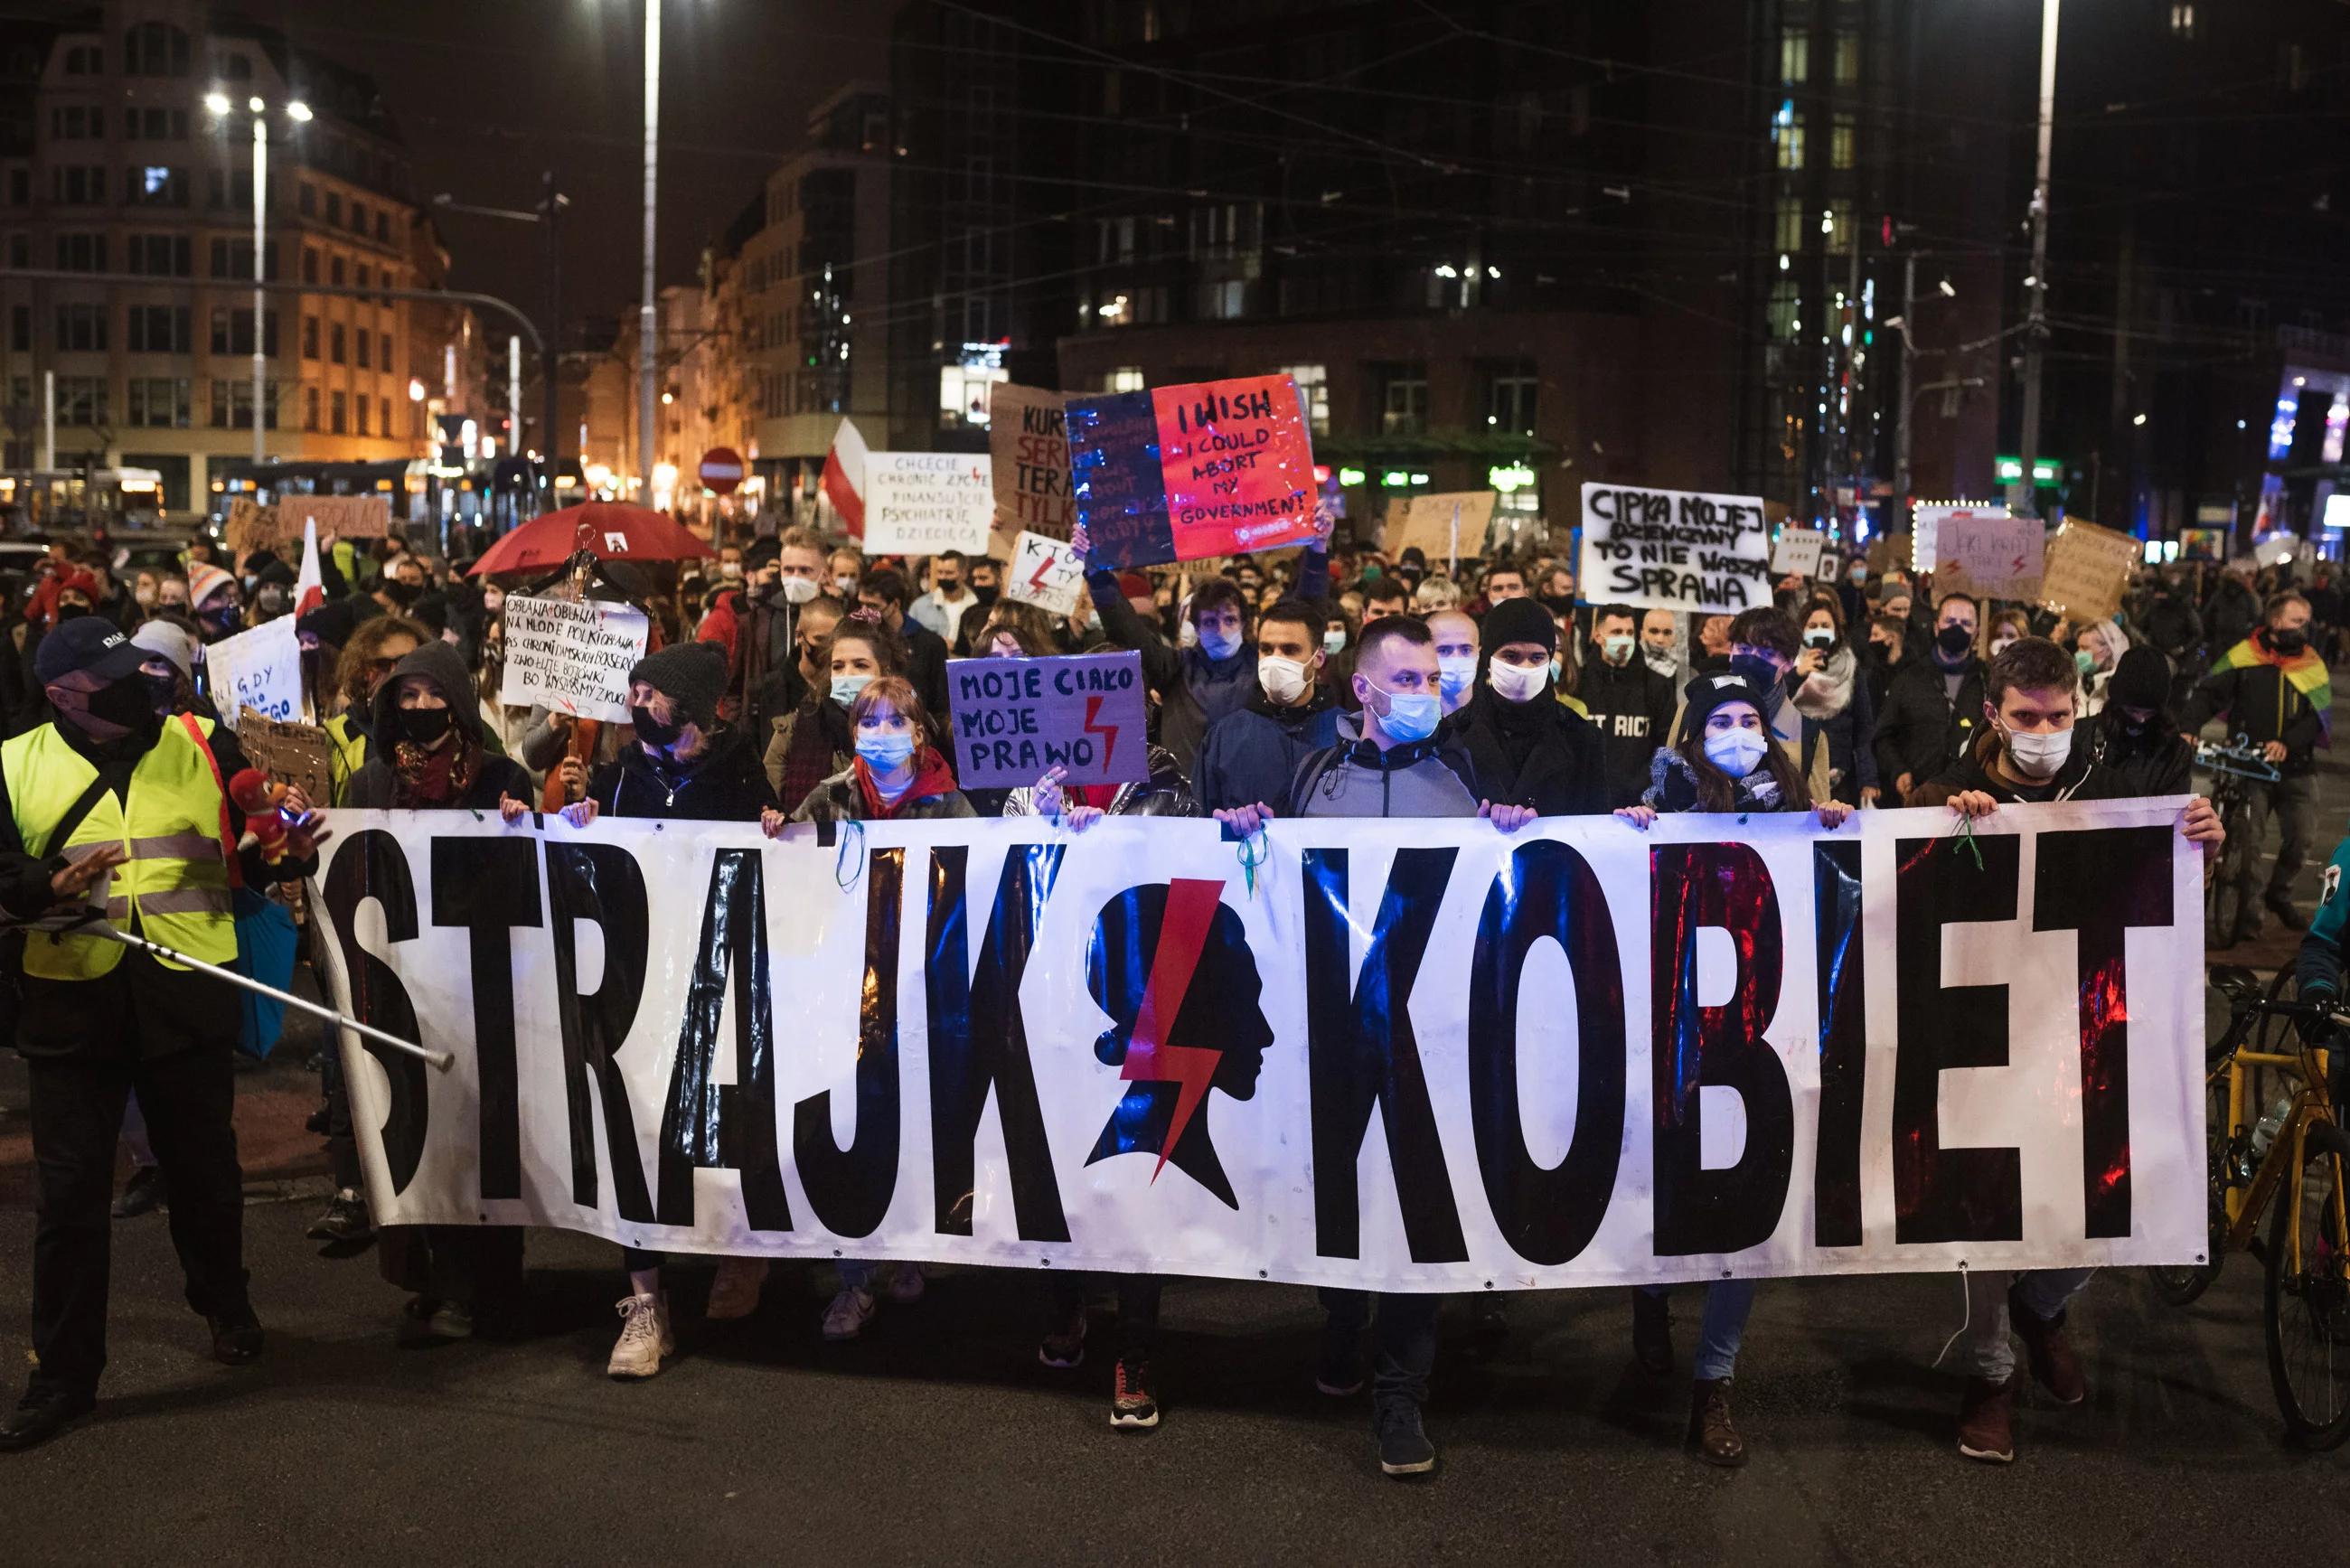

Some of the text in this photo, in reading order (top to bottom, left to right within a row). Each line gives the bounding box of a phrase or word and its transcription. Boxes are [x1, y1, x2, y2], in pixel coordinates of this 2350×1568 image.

[1023, 405, 1064, 437] KUR
[1179, 405, 1188, 434] I
[1195, 389, 1272, 427] WISH
[1016, 435, 1070, 469] SERI
[1199, 428, 1270, 453] COULD
[895, 457, 959, 471] CHCECIE
[1016, 461, 1074, 496] TERA
[1192, 450, 1262, 481] ABORT
[892, 491, 985, 508] FINANSUJCIE
[1213, 477, 1238, 494] MY
[1014, 491, 1077, 525] TYLK
[1180, 490, 1306, 524] GOVERNMENT
[1590, 490, 1763, 532] CIPKA MOJEJ
[1027, 539, 1076, 565] KTO
[1593, 541, 1632, 560] TO
[1640, 543, 1689, 564] NIE
[1058, 568, 1080, 584] TY
[1609, 564, 1748, 607] SPRAWA
[506, 615, 522, 631] NA
[595, 650, 637, 671] BOKSERÓ
[215, 666, 271, 702] NIGDY
[523, 671, 540, 685] BO
[960, 668, 1041, 701] MOJE
[960, 709, 1039, 737] MOJE
[970, 738, 1094, 770] PRAWO
[323, 824, 2175, 1265] STRAJK KOBIET
